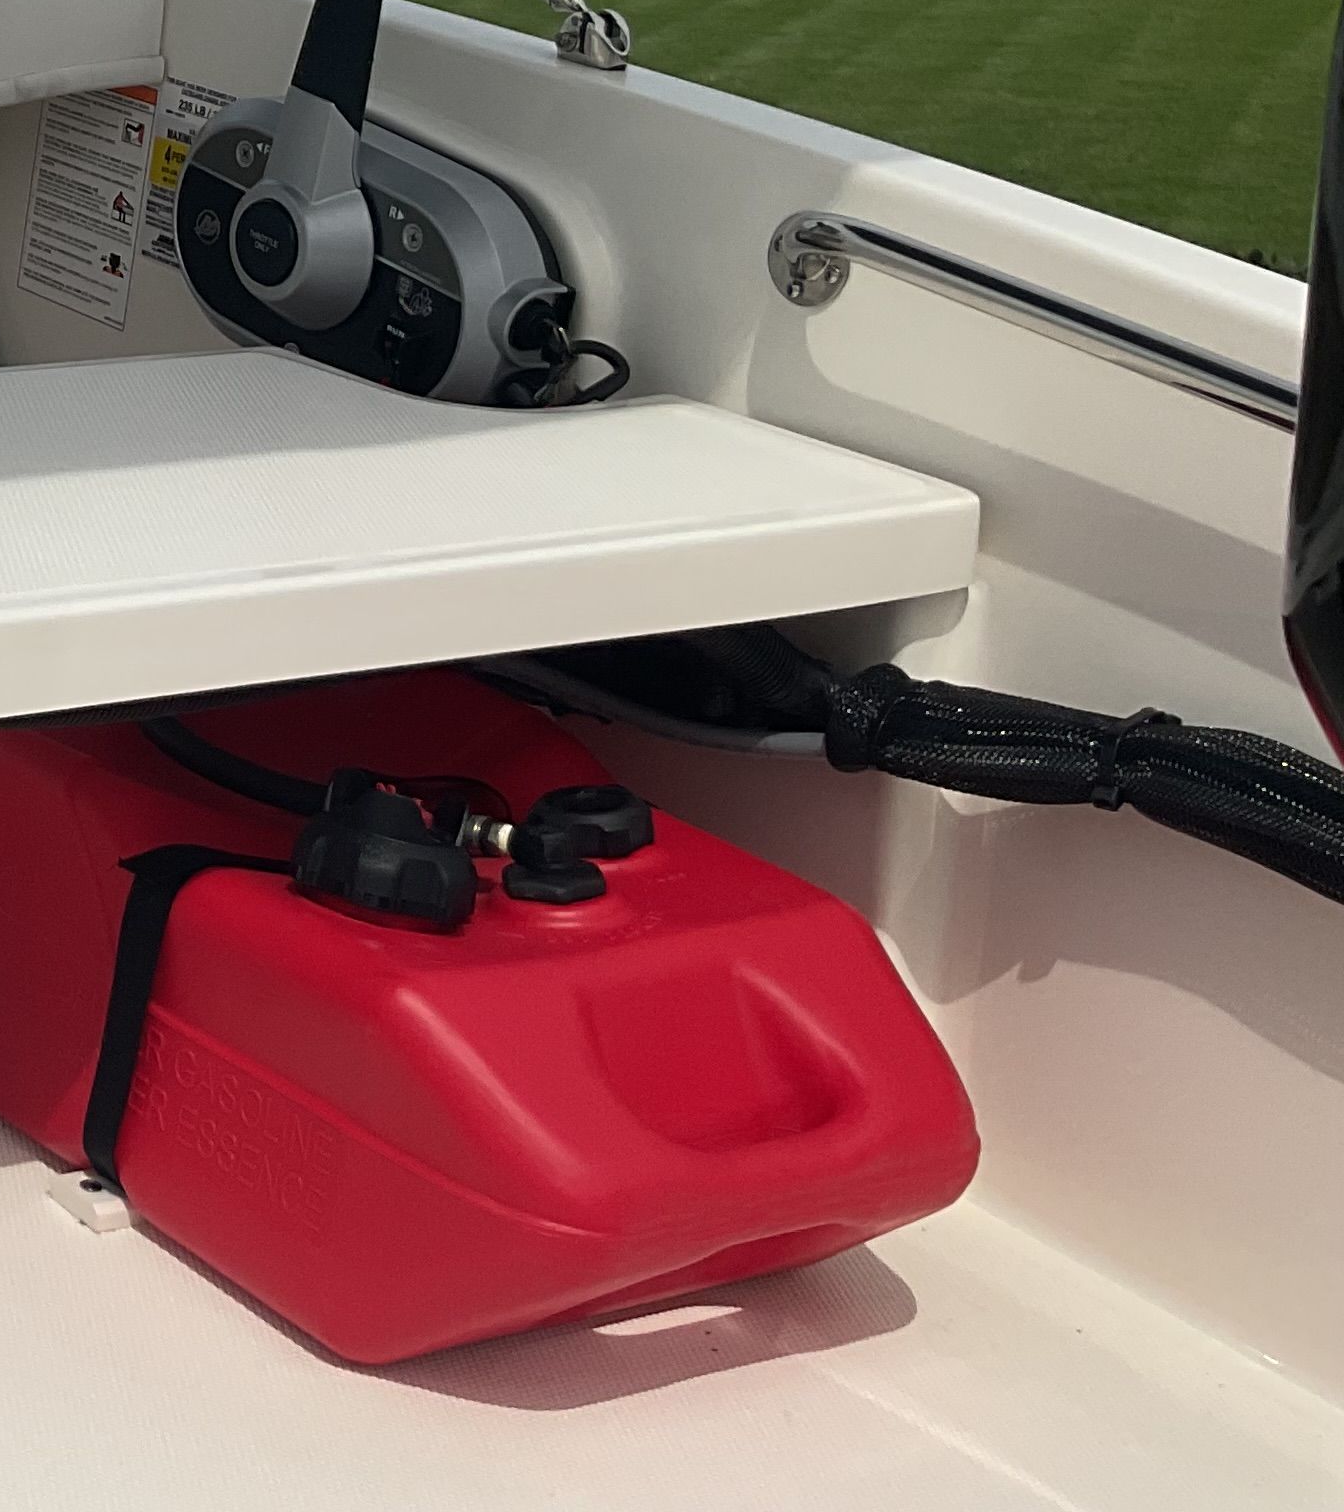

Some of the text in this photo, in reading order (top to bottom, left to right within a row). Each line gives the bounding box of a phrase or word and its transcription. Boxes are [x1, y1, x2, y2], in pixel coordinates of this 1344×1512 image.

[388, 206, 397, 219] R
[174, 1048, 333, 1176] GASOLINE
[176, 1106, 326, 1234] ESSENCE
